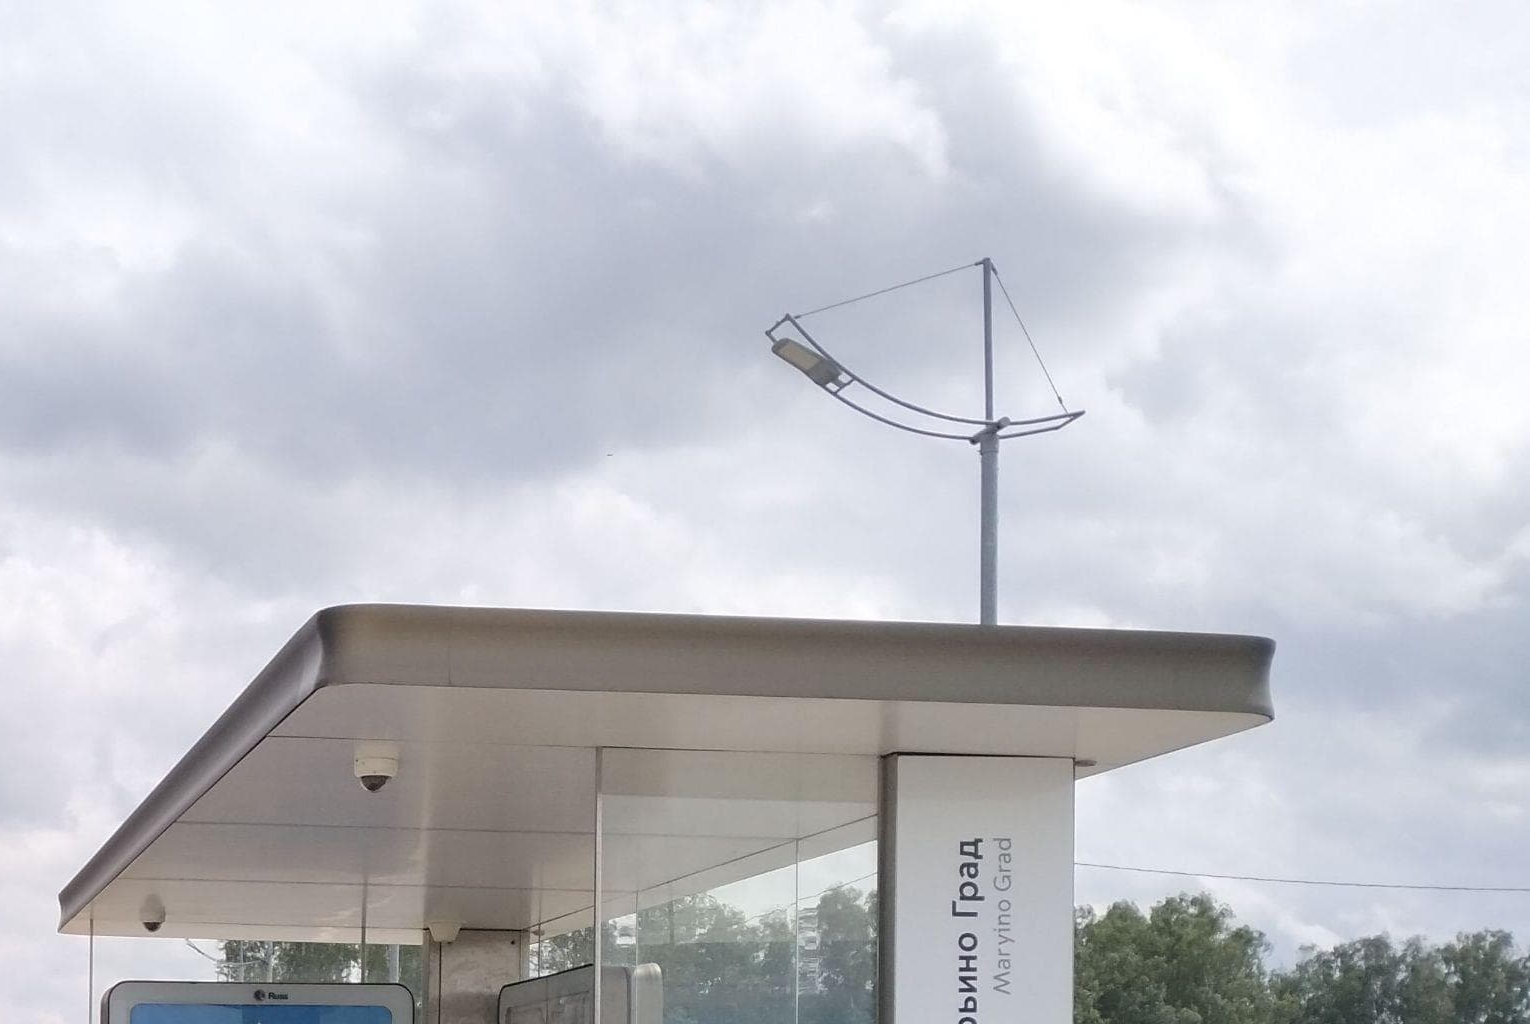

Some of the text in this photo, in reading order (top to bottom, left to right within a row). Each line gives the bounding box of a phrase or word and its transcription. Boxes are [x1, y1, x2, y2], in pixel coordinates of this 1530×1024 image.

[951, 837, 985, 918] Град
[992, 837, 1015, 995] Maryino Grad
